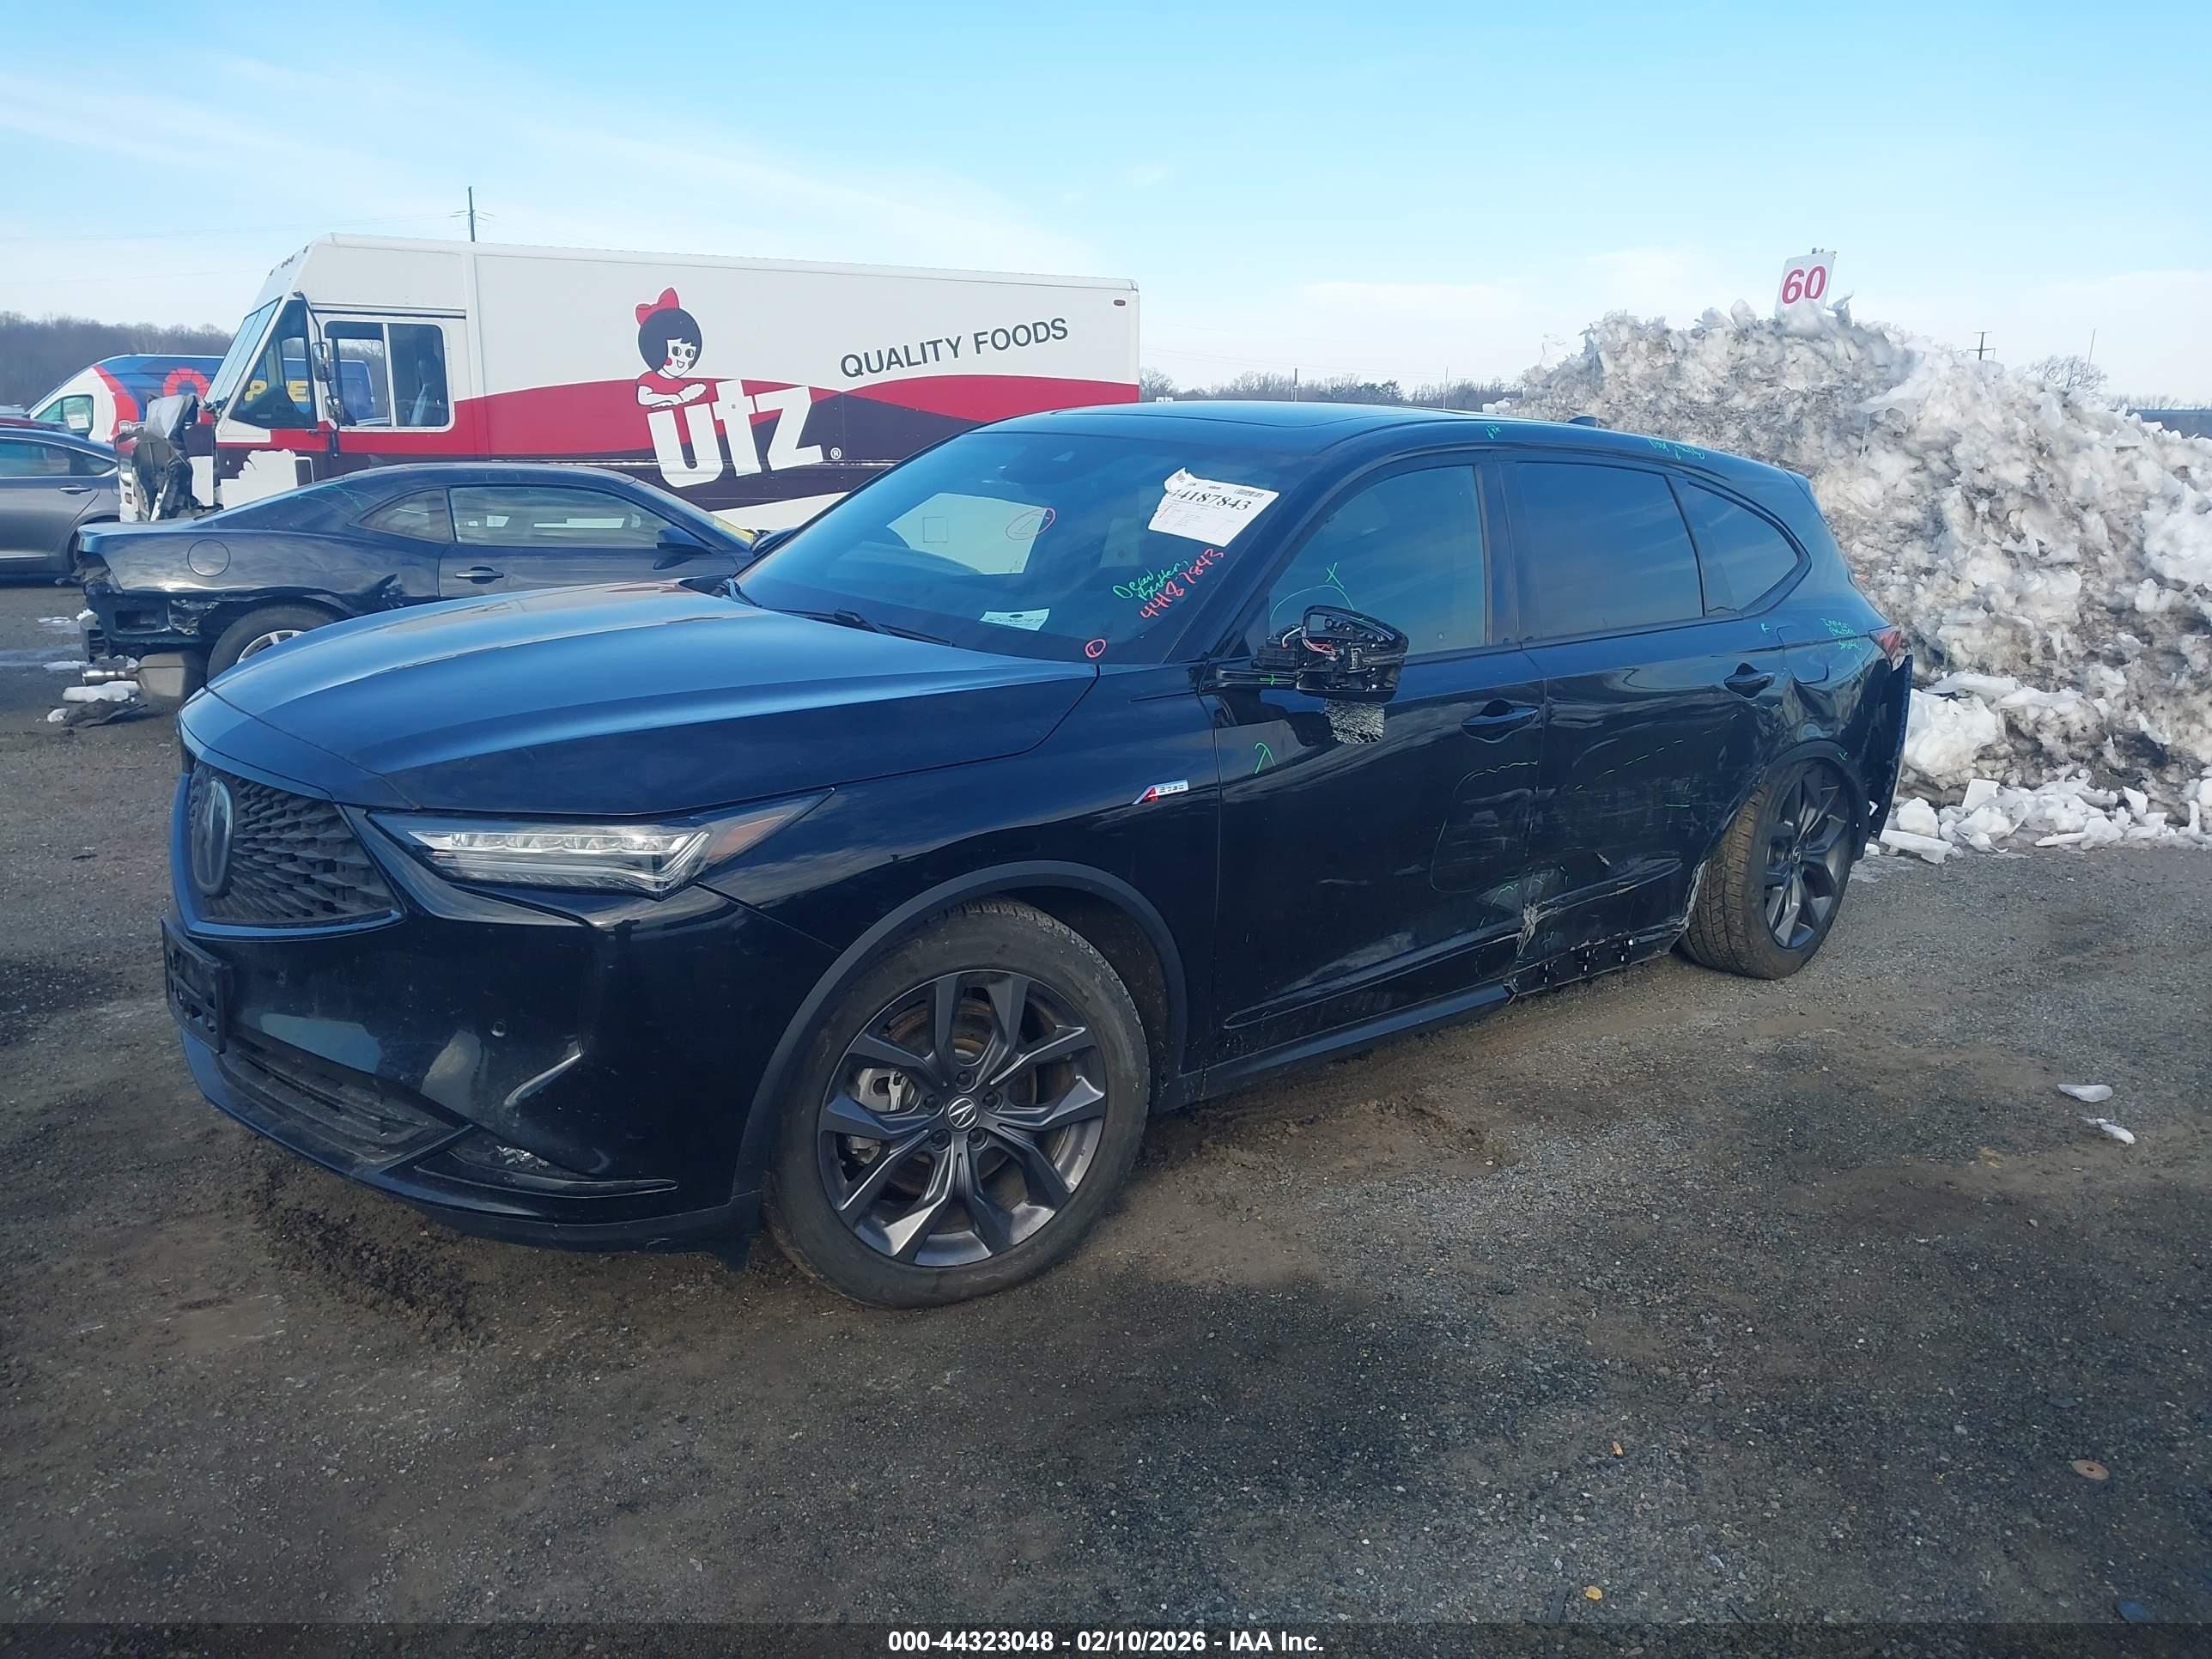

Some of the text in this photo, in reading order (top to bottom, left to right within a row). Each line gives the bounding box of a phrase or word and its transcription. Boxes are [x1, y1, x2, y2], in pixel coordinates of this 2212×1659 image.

[1782, 265, 1826, 304] 60
[840, 318, 1069, 378] QUALITY FOODS
